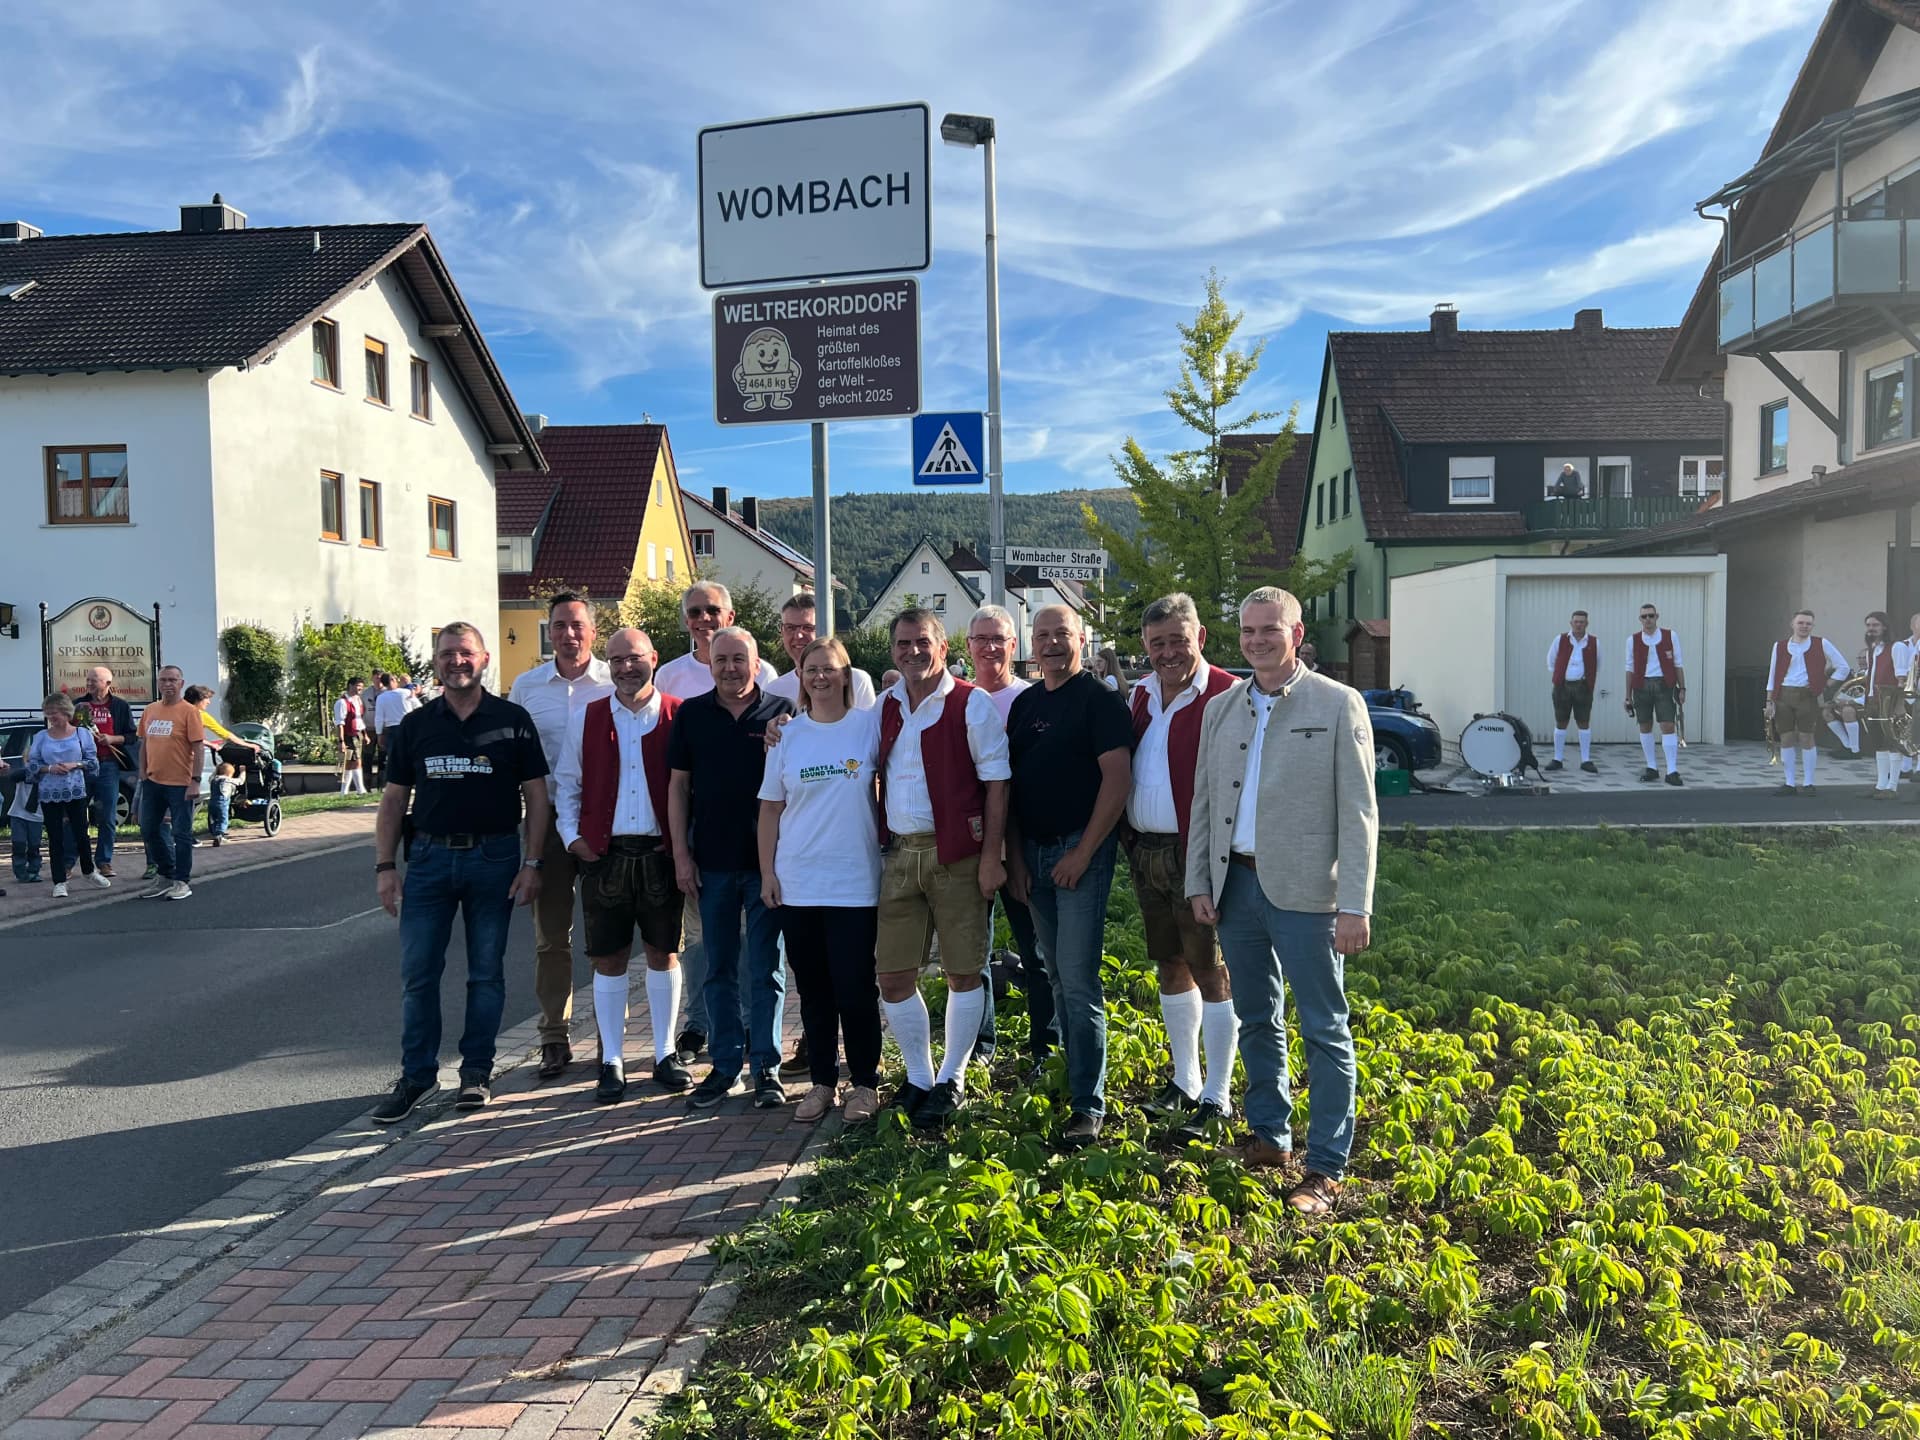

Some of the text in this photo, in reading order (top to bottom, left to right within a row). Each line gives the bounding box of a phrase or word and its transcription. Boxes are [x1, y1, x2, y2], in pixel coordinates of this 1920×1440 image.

[717, 172, 910, 222] WOMBACH
[723, 291, 908, 324] WELTREKORDDORF
[817, 322, 880, 338] Heimat des
[817, 342, 860, 358] größten
[817, 355, 901, 372] Kartoffelkloßes
[749, 376, 786, 390] 464,8 kg
[818, 375, 837, 389] der
[839, 374, 865, 387] Welt
[818, 389, 893, 408] gekocht 2025
[1012, 549, 1102, 564] Wombacher Straße
[58, 646, 145, 657] SPESSARTTOR
[424, 758, 445, 766] WIR
[446, 757, 471, 765] SIND
[800, 765, 828, 773] ALWAYS
[426, 765, 493, 774] WELTREKORD
[800, 768, 848, 779] ROUND THING
